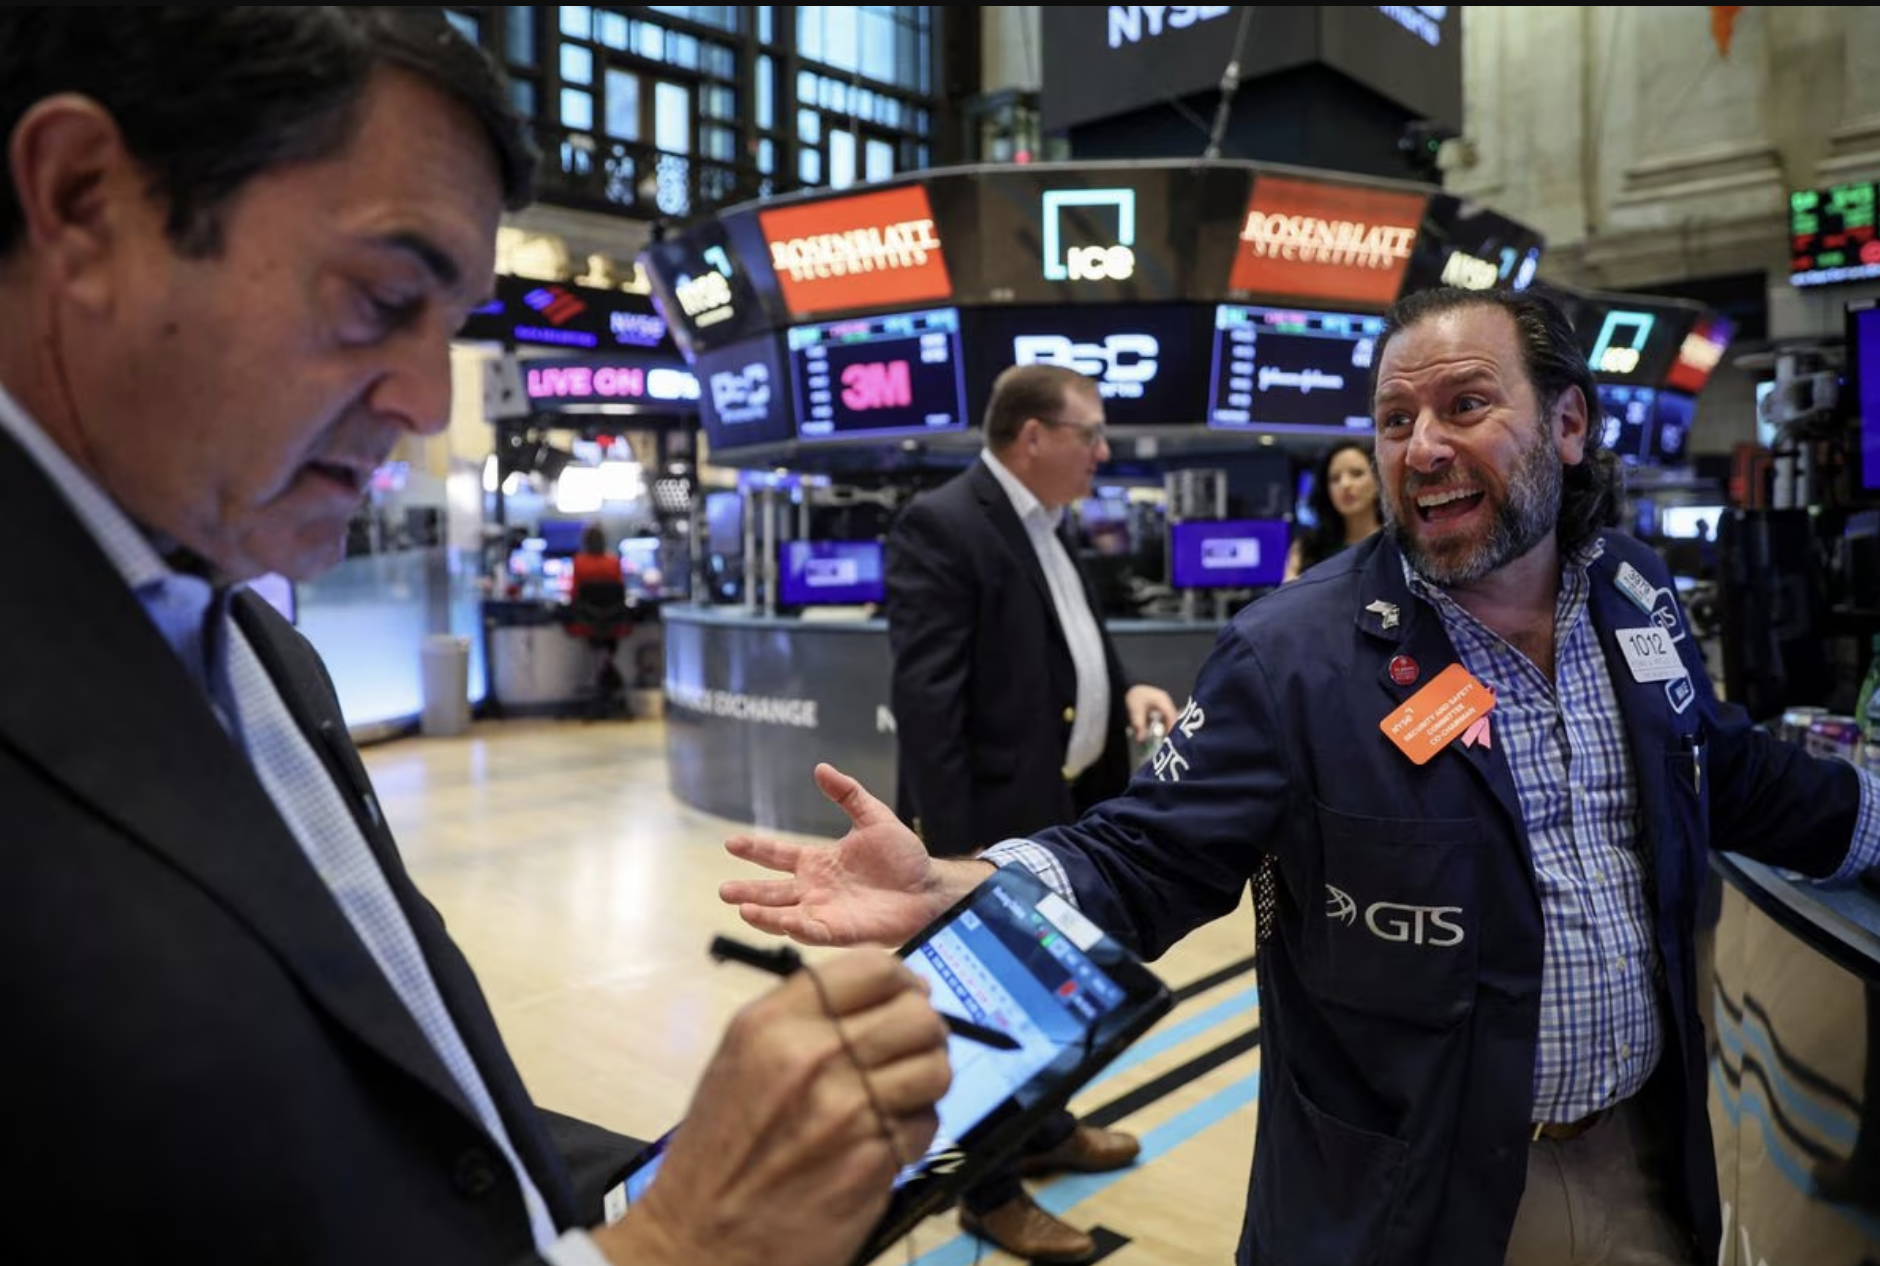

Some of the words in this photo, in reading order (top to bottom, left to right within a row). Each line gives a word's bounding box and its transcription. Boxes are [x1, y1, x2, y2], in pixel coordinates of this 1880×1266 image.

[1239, 211, 1418, 258] ROSENBLATT
[527, 368, 592, 397] LIVE
[593, 367, 645, 396] ON
[841, 359, 912, 411] 3M
[1629, 633, 1667, 656] 1012
[714, 693, 818, 728] EXCHANGE
[1365, 901, 1464, 946] GTS
